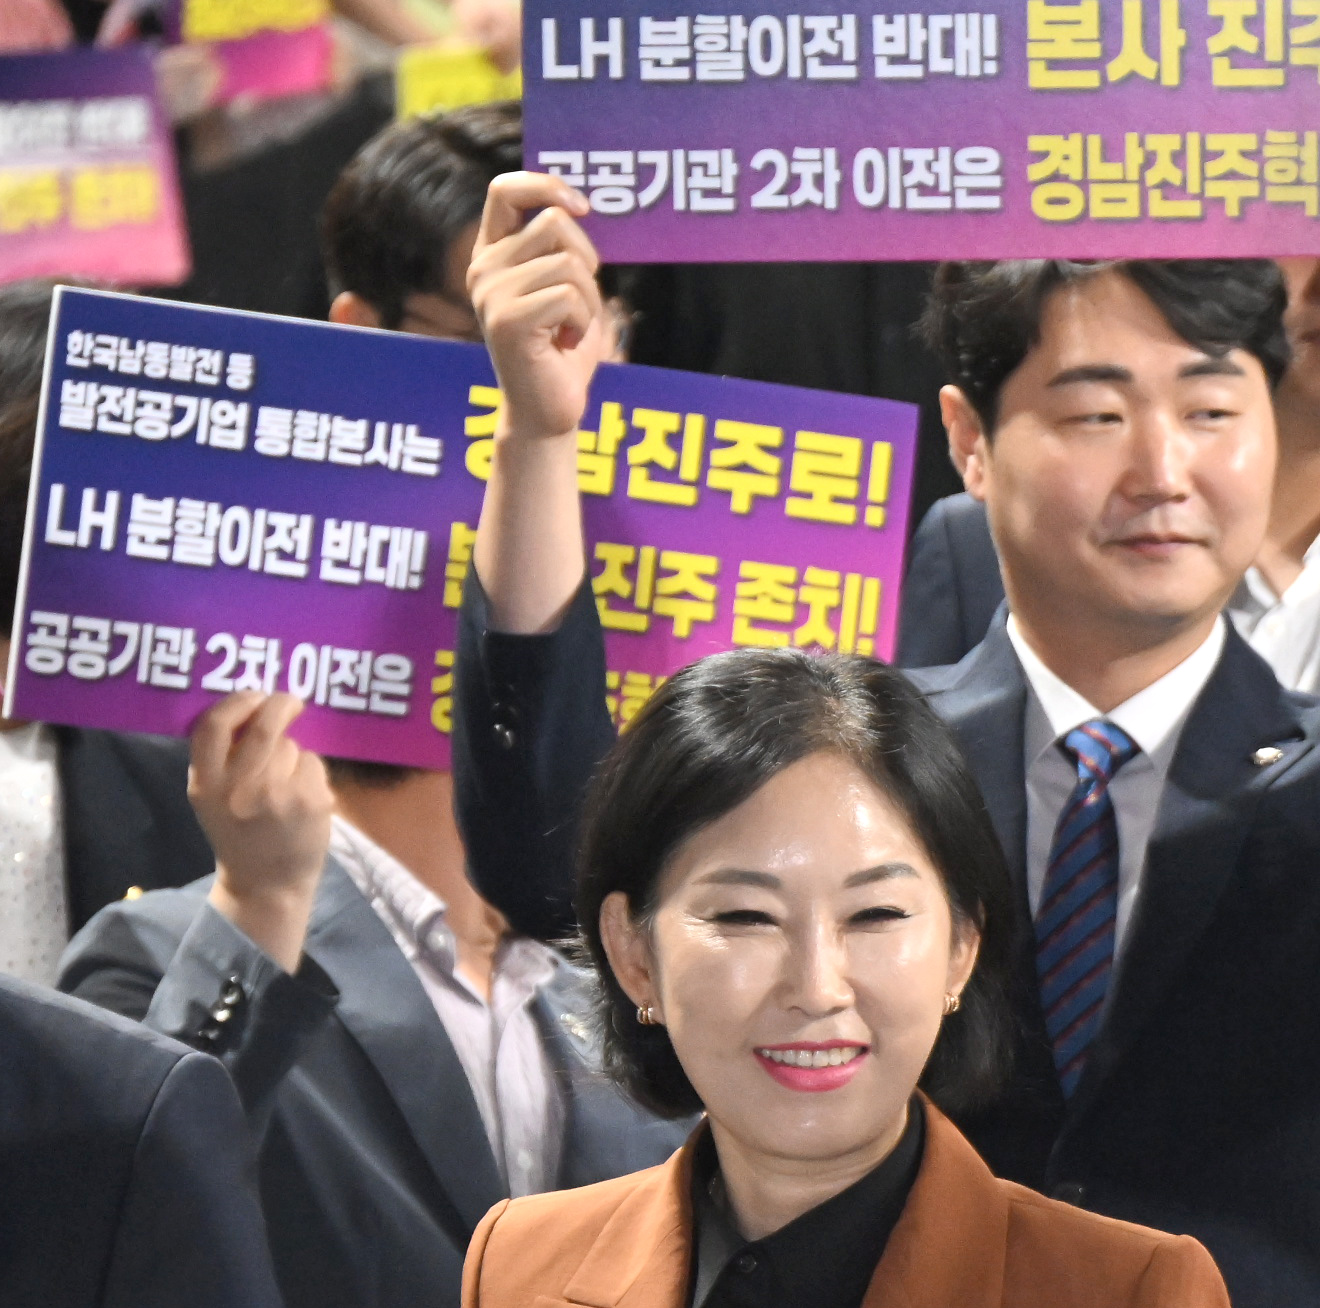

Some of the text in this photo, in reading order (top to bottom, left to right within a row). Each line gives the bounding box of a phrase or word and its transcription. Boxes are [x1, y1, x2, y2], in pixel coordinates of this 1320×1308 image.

[542, 18, 622, 78] LH
[639, 14, 857, 80] 분할이전
[873, 13, 997, 77] 반대!
[1027, 0, 1186, 88] 본사
[750, 147, 840, 209] 2차
[853, 147, 1001, 209] 이전은
[66, 330, 252, 389] 한국남동발전 등
[59, 380, 249, 449] 발전공기업
[254, 406, 441, 475] 통합본사는
[45, 484, 119, 550] LH
[126, 494, 312, 577] 분할이전
[320, 519, 426, 588] 반대!
[592, 542, 718, 639] 진주
[732, 560, 881, 656] 존치!
[26, 611, 197, 688] 공공기관
[201, 632, 280, 696] 2차
[288, 642, 413, 716] 이전은
